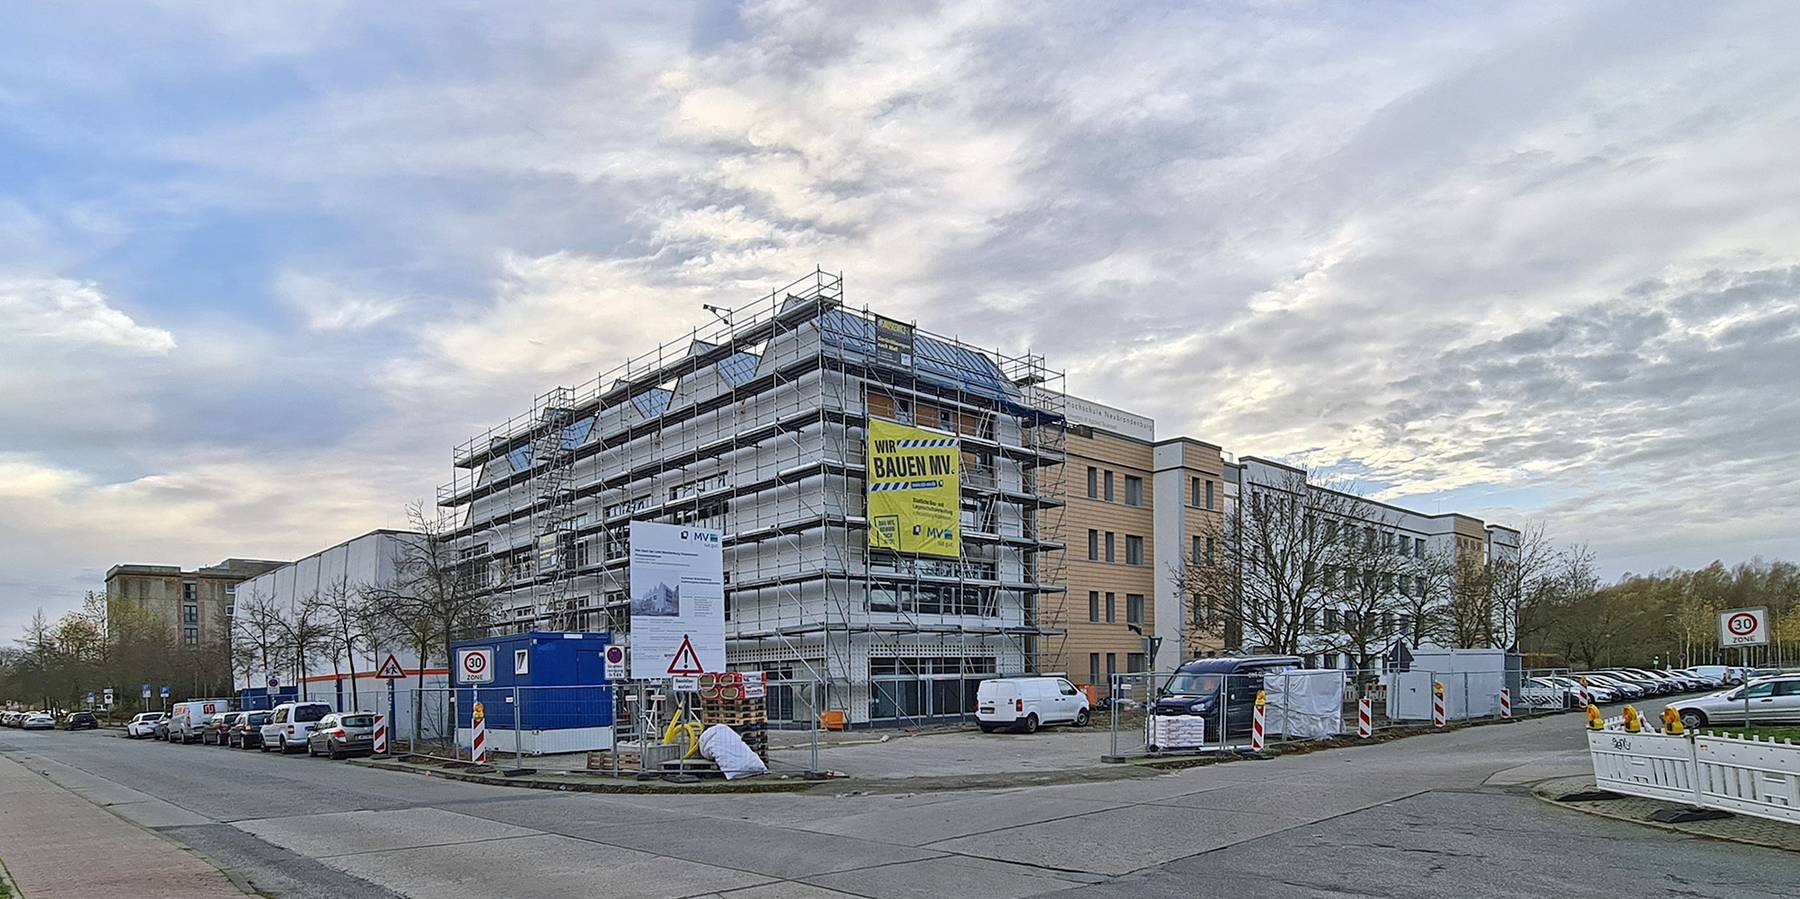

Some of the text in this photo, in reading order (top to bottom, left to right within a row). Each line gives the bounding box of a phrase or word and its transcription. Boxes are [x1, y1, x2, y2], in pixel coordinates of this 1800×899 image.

[1104, 411, 1152, 432] Neubrandenburg
[875, 439, 896, 454] WIR
[873, 455, 927, 478] BAUEN
[694, 532, 709, 541] MV
[926, 526, 943, 538] MV
[1733, 618, 1752, 630] 30
[468, 657, 482, 668] 30
